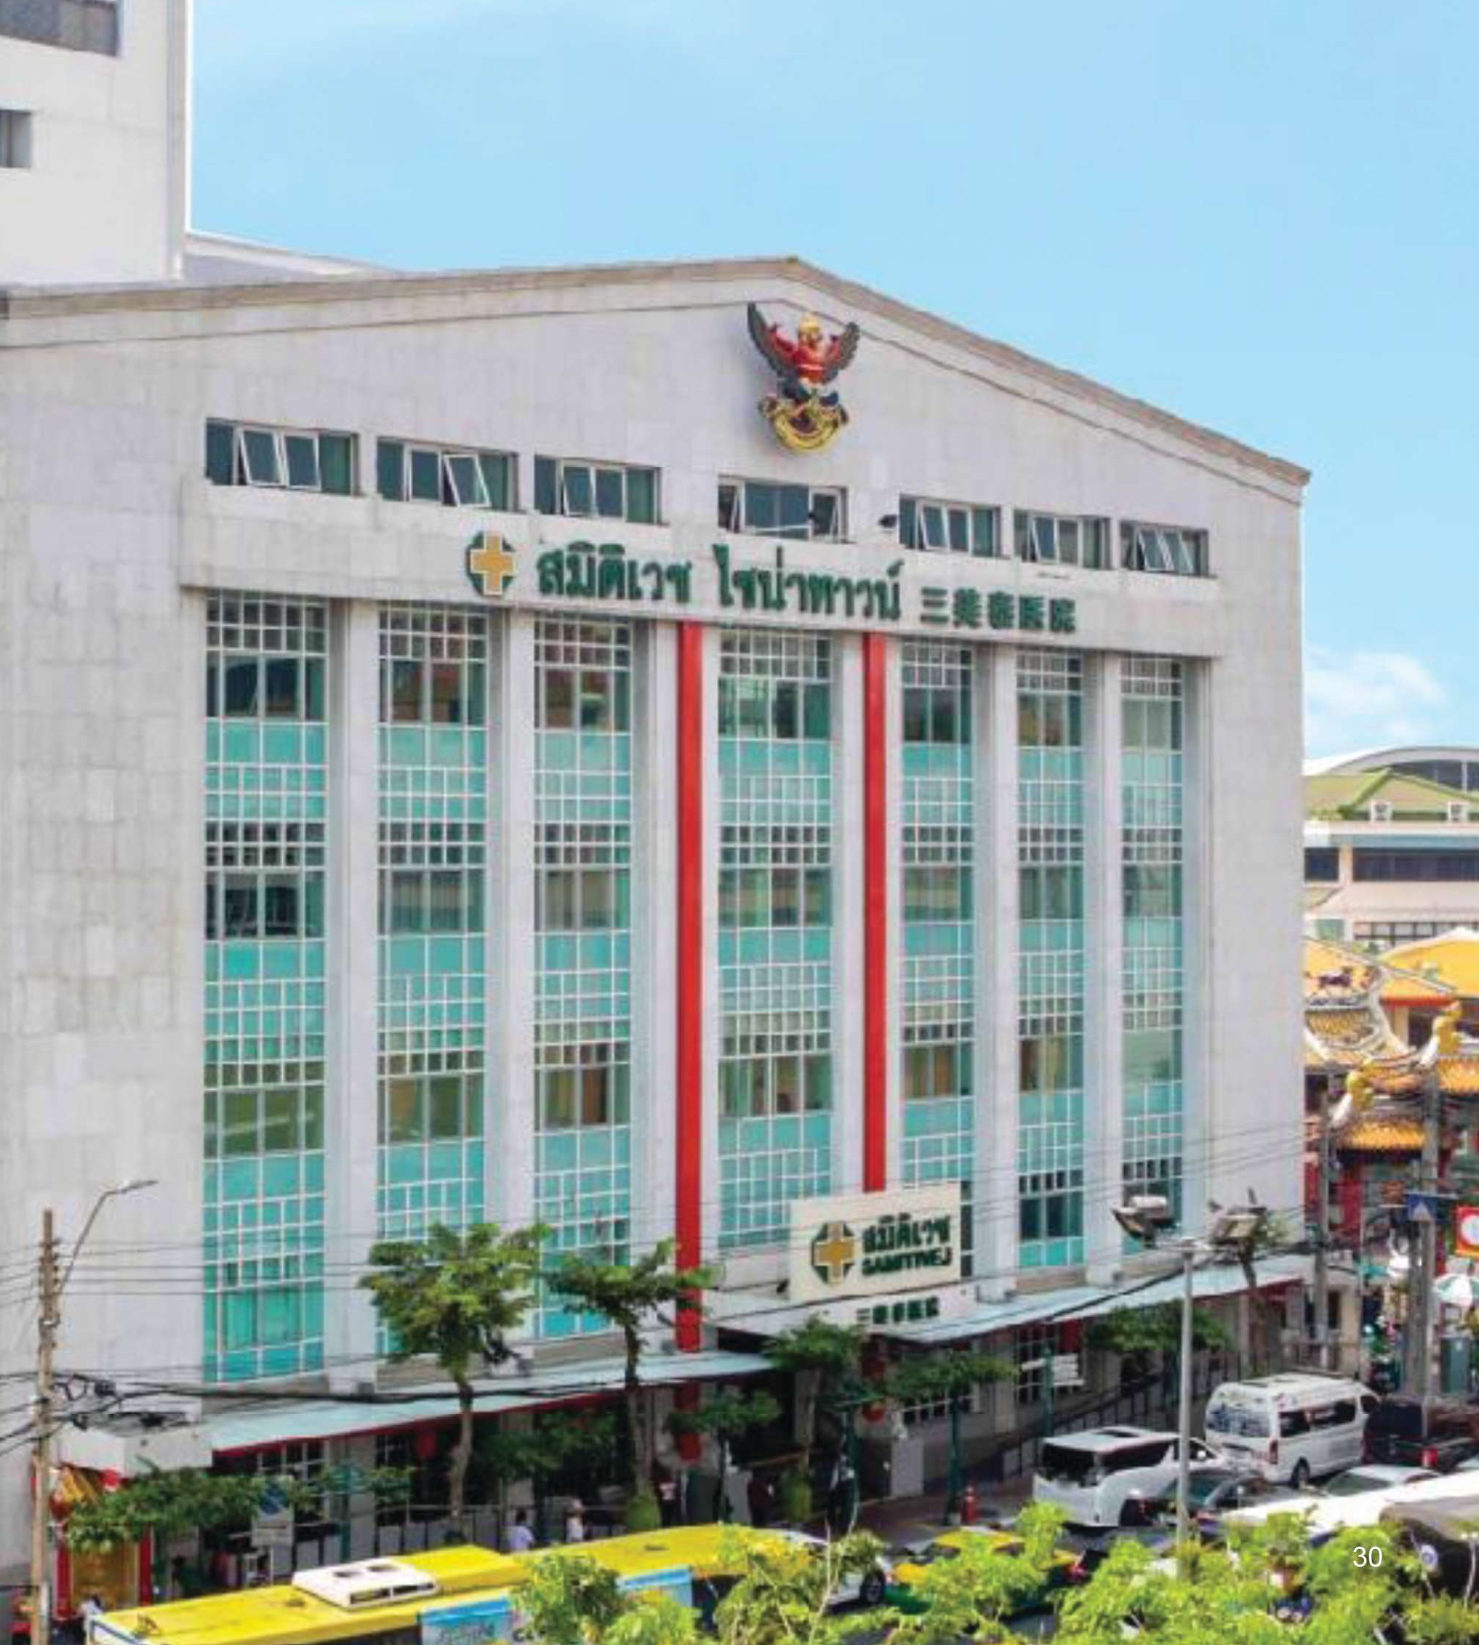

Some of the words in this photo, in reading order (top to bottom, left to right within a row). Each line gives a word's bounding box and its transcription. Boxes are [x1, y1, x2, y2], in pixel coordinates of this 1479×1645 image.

[537, 541, 692, 602] สมิติเวช
[712, 544, 904, 621] ไชน่าทาวน์
